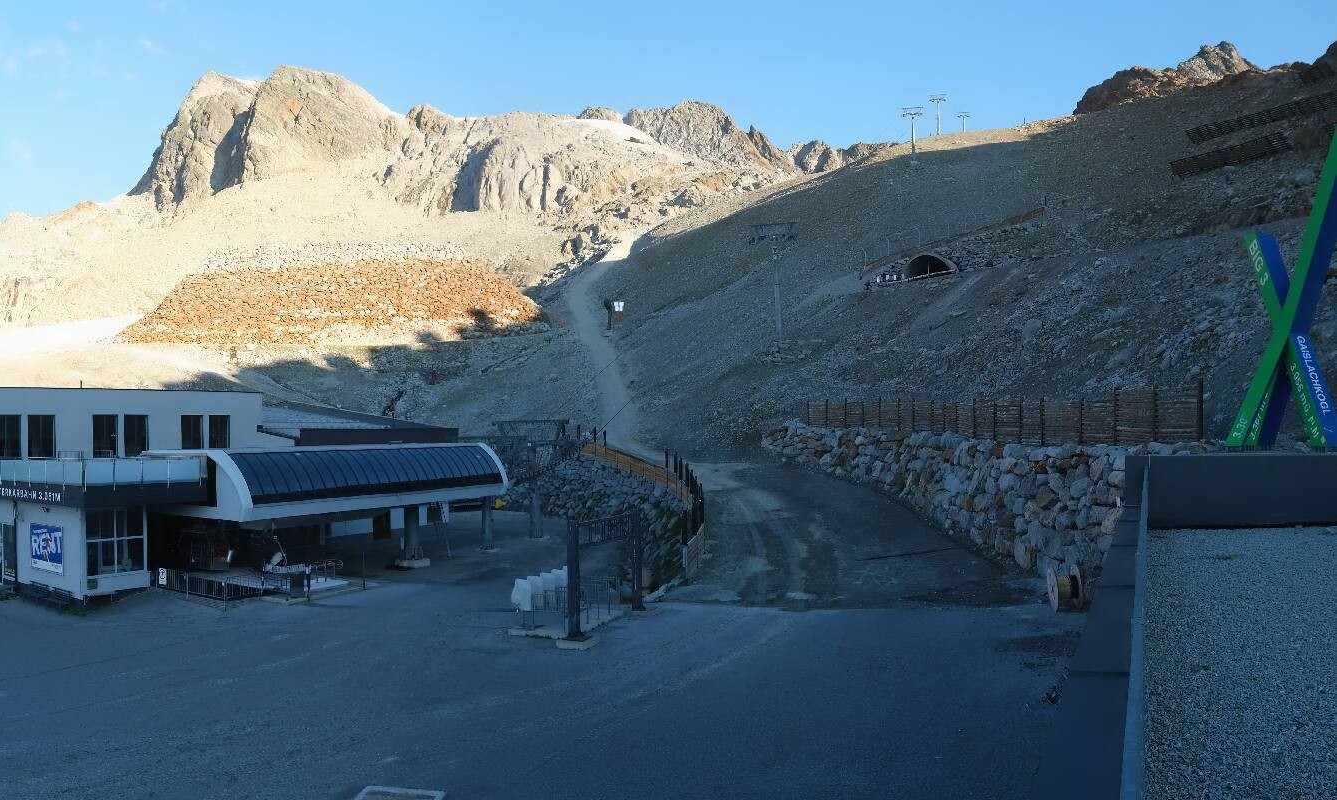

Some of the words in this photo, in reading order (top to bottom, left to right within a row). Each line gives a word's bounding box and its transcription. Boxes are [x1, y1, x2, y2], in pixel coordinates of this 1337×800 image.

[1249, 239, 1264, 272] BIG
[1260, 272, 1268, 286] 3
[1296, 335, 1331, 416] GAISLACHKOGL
